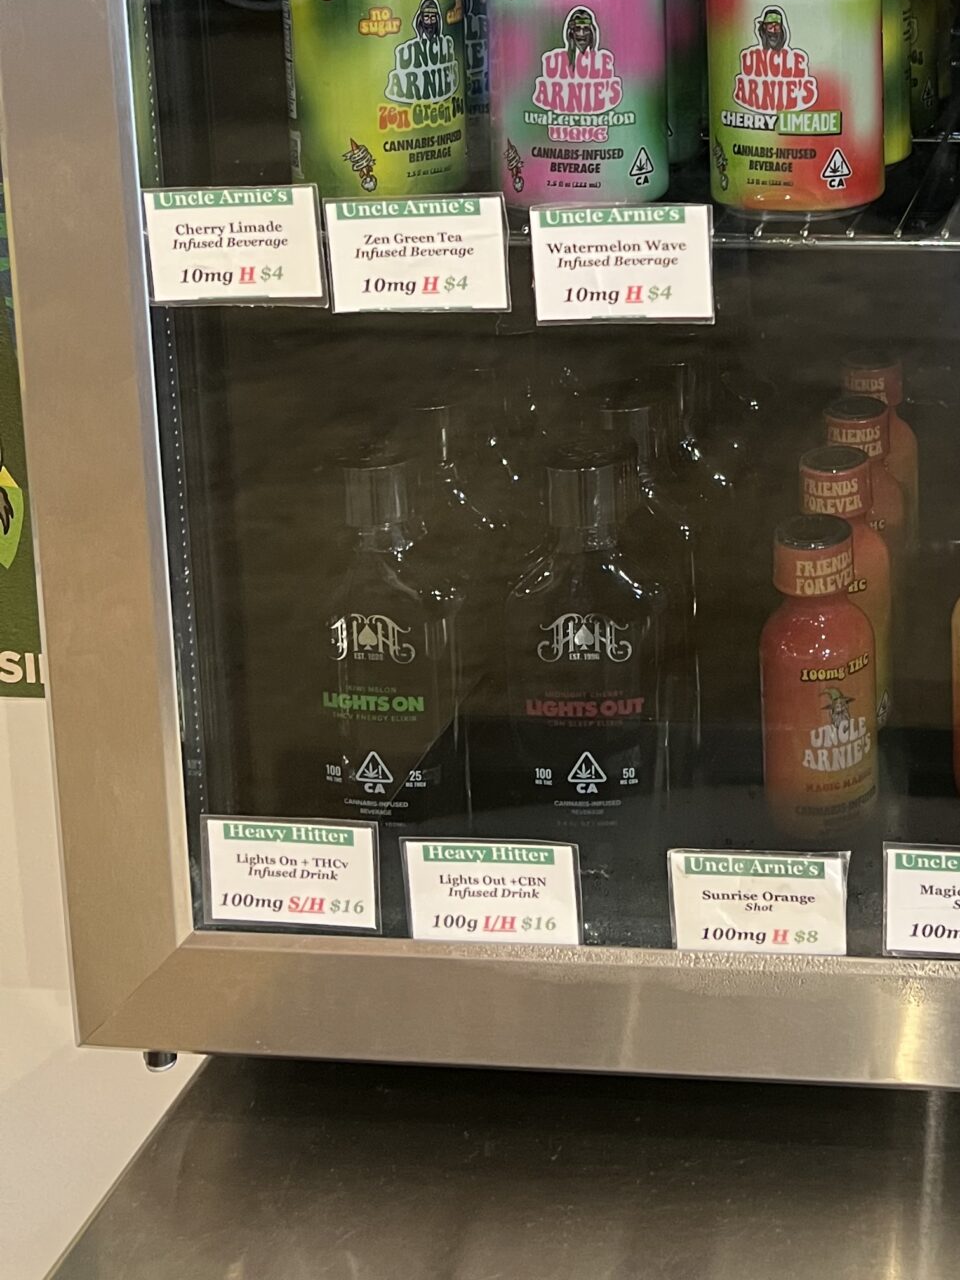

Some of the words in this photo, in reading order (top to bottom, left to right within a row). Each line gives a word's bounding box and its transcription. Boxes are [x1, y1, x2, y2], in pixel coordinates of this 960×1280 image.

[373, 8, 389, 21] no
[360, 19, 401, 35] sugar
[742, 49, 805, 79] UNCLE
[735, 78, 815, 110] ARNIE'S
[721, 112, 778, 130] CHERRY
[780, 113, 837, 132] LIMEADE
[733, 143, 817, 159] CANNABIS-INFUSED
[749, 160, 792, 172] BEVERAGE
[159, 191, 214, 206] Uncle
[220, 189, 287, 204] Arnie's
[176, 224, 224, 237] Cherry
[230, 221, 282, 233] Limade
[173, 237, 222, 251] Infused
[227, 238, 288, 248] Beverage
[364, 235, 389, 244] Zen
[394, 234, 434, 243] Green
[438, 232, 462, 242] Tea
[547, 240, 640, 253] Watermelon
[645, 240, 686, 250] Wave
[323, 692, 389, 713] LIGHTS
[392, 696, 424, 711] ON
[526, 698, 597, 717] LIGHTS
[600, 697, 644, 715] OUT
[229, 824, 287, 841] Heavy
[291, 827, 348, 842] Hitter
[237, 854, 276, 866] Lights
[280, 856, 297, 865] On
[312, 858, 348, 868] THCv
[248, 866, 296, 878] Infused
[300, 870, 337, 880] Drink
[440, 874, 479, 886] Lights
[483, 876, 505, 885] Out
[511, 877, 546, 886] +CBN
[449, 887, 497, 899] Infused
[501, 888, 539, 898] Drink
[703, 890, 757, 900] Sunrise
[763, 892, 815, 904] Orange
[222, 893, 283, 912] 100mg
[288, 897, 324, 913] S/H
[330, 899, 364, 914] $16
